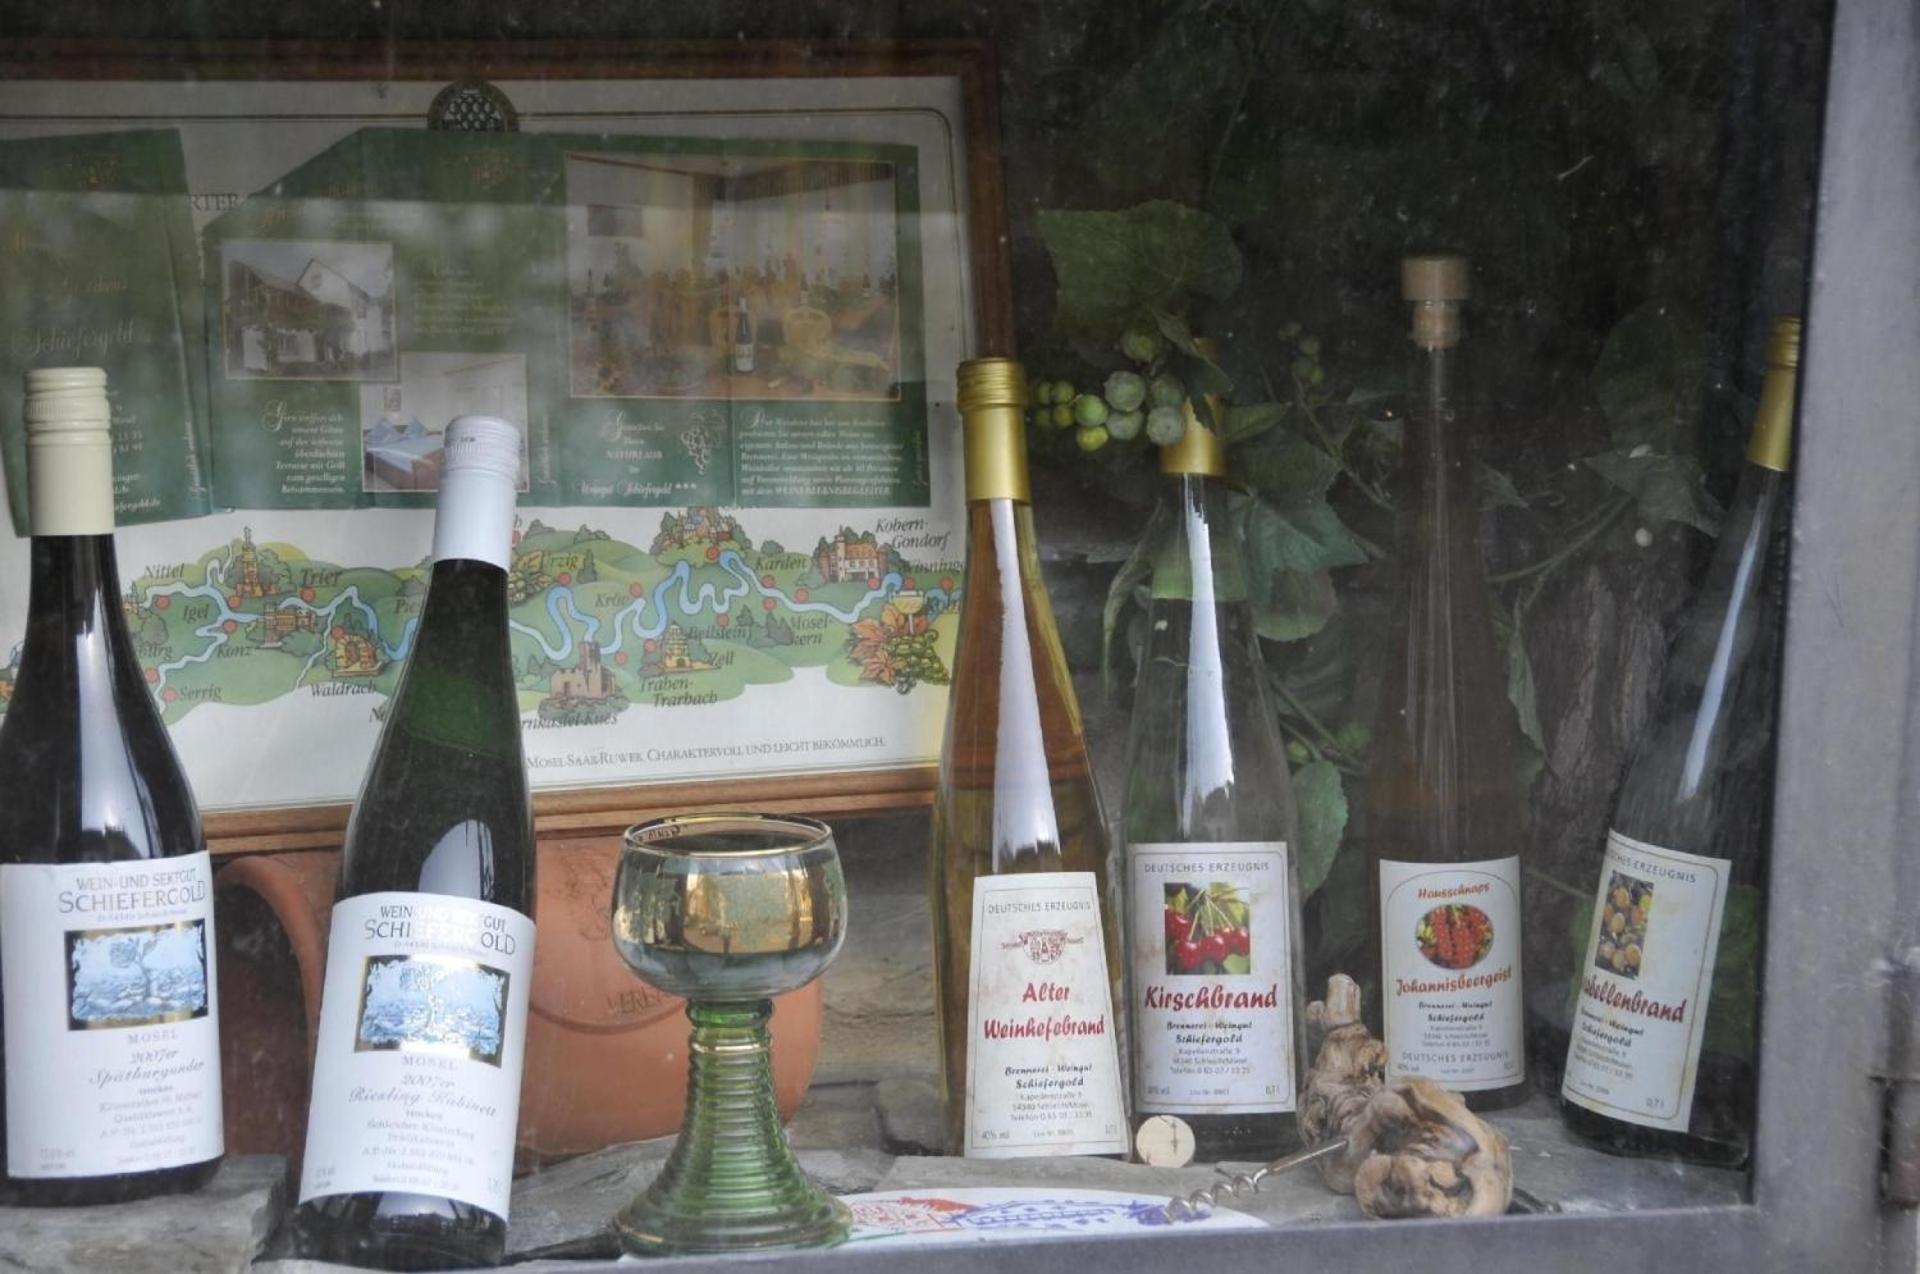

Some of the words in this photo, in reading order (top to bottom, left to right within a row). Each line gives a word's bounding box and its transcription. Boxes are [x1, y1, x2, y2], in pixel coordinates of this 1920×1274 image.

[892, 531, 951, 551] Gondorf
[755, 555, 807, 571] Karden
[299, 568, 342, 586] Trier
[182, 603, 210, 624] Igel
[310, 679, 377, 698] Waldrach
[653, 689, 718, 708] Trarbach
[522, 711, 618, 731] rnkastel-Kues
[1144, 861, 1205, 875] DEUTSCHES
[1208, 861, 1270, 874] ERZEUGNIS
[1632, 858, 1697, 884] ERZEUGNIS
[58, 880, 206, 914] SCHIEFERGOLD
[987, 902, 1042, 915] DEUTSCHES
[1396, 964, 1512, 997] Johannisbeergeist
[1021, 982, 1071, 1004] Alter
[1143, 983, 1278, 1012] Kirschbrand
[983, 1014, 1106, 1042] Weinhefebrand
[1175, 1033, 1244, 1047] Schiefergold
[401, 1055, 458, 1072] MOSEL
[1015, 1076, 1085, 1091] Schiefergold
[348, 1086, 421, 1106] Riesling
